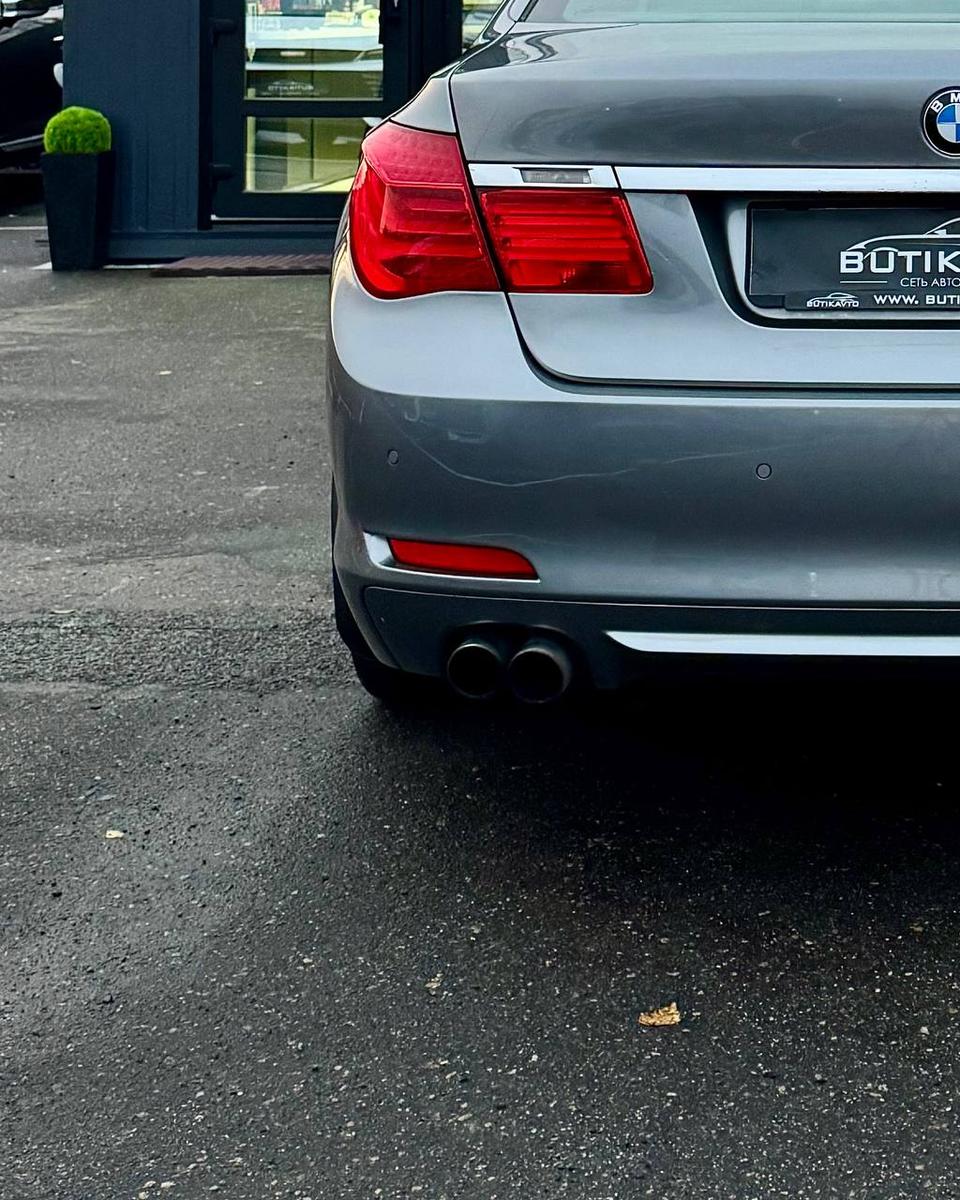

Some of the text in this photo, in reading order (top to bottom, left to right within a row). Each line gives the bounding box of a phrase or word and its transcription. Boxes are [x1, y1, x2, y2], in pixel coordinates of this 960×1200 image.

[900, 277, 929, 287] СЕТЬ
[806, 300, 860, 308] BUTIKAVTO
[873, 294, 919, 305] WWW.
